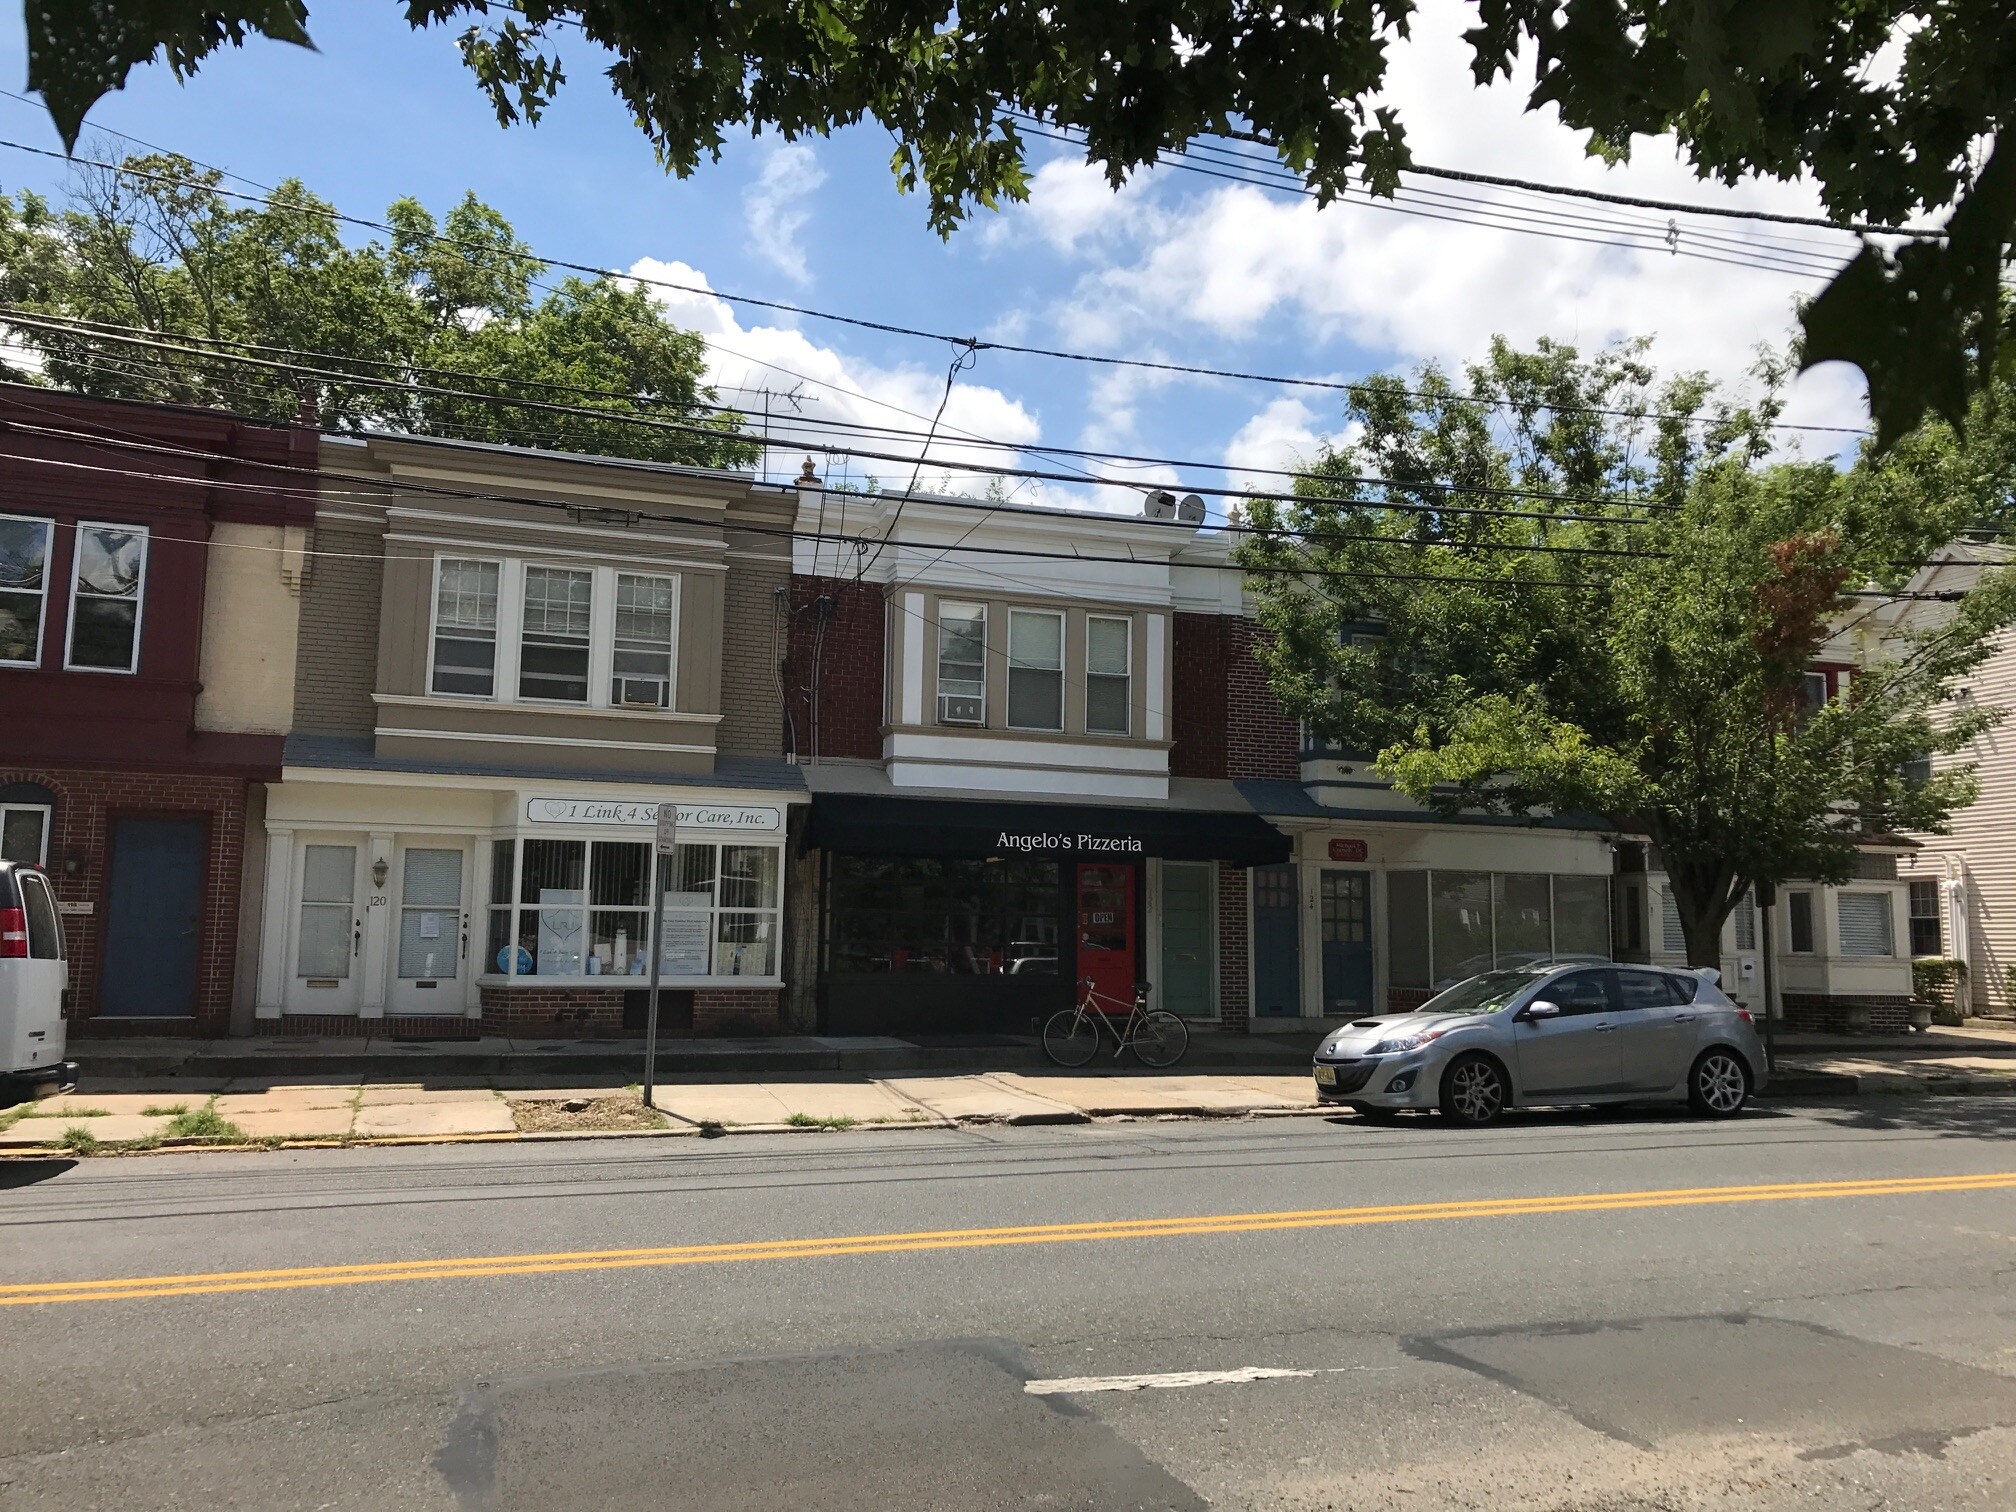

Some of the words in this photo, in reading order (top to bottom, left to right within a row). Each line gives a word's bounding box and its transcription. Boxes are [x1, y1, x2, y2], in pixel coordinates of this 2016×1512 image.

[569, 805, 577, 817] 1
[582, 804, 626, 822] Link
[627, 807, 637, 819] 4
[641, 808, 693, 821] Seor
[696, 810, 733, 825] Care,
[736, 812, 765, 824] Inc.
[996, 832, 1072, 852] Angelo's
[1077, 834, 1143, 852] Pizzeria
[370, 896, 387, 907] 120
[1094, 913, 1113, 923] OPEN
